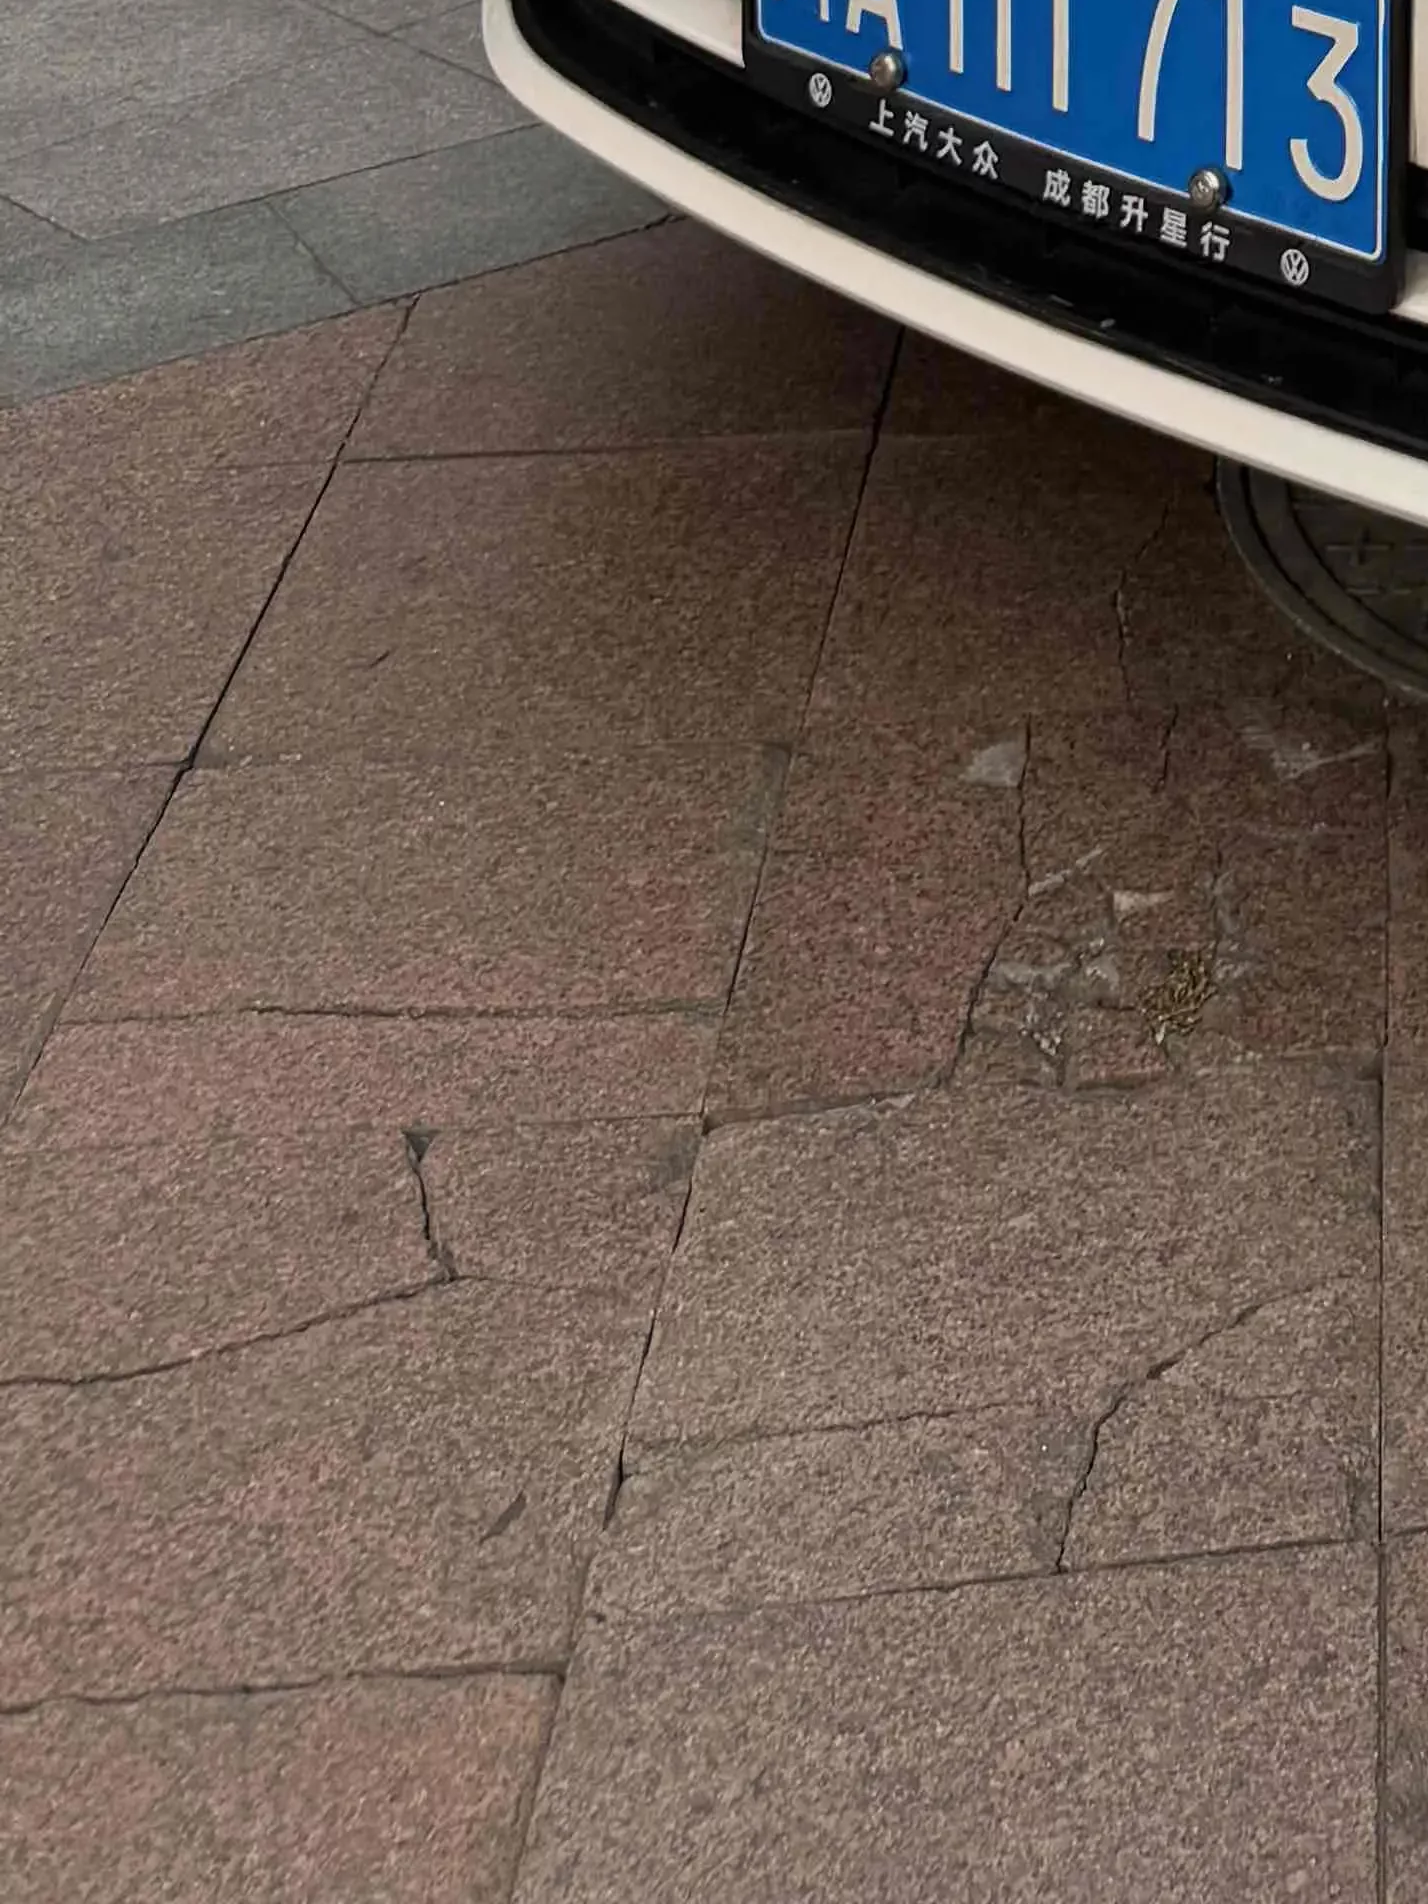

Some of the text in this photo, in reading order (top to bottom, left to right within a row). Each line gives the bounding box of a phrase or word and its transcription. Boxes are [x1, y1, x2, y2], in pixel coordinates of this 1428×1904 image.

[868, 99, 1001, 182] 上汽大众
[1042, 168, 1233, 264] 成都升星行
